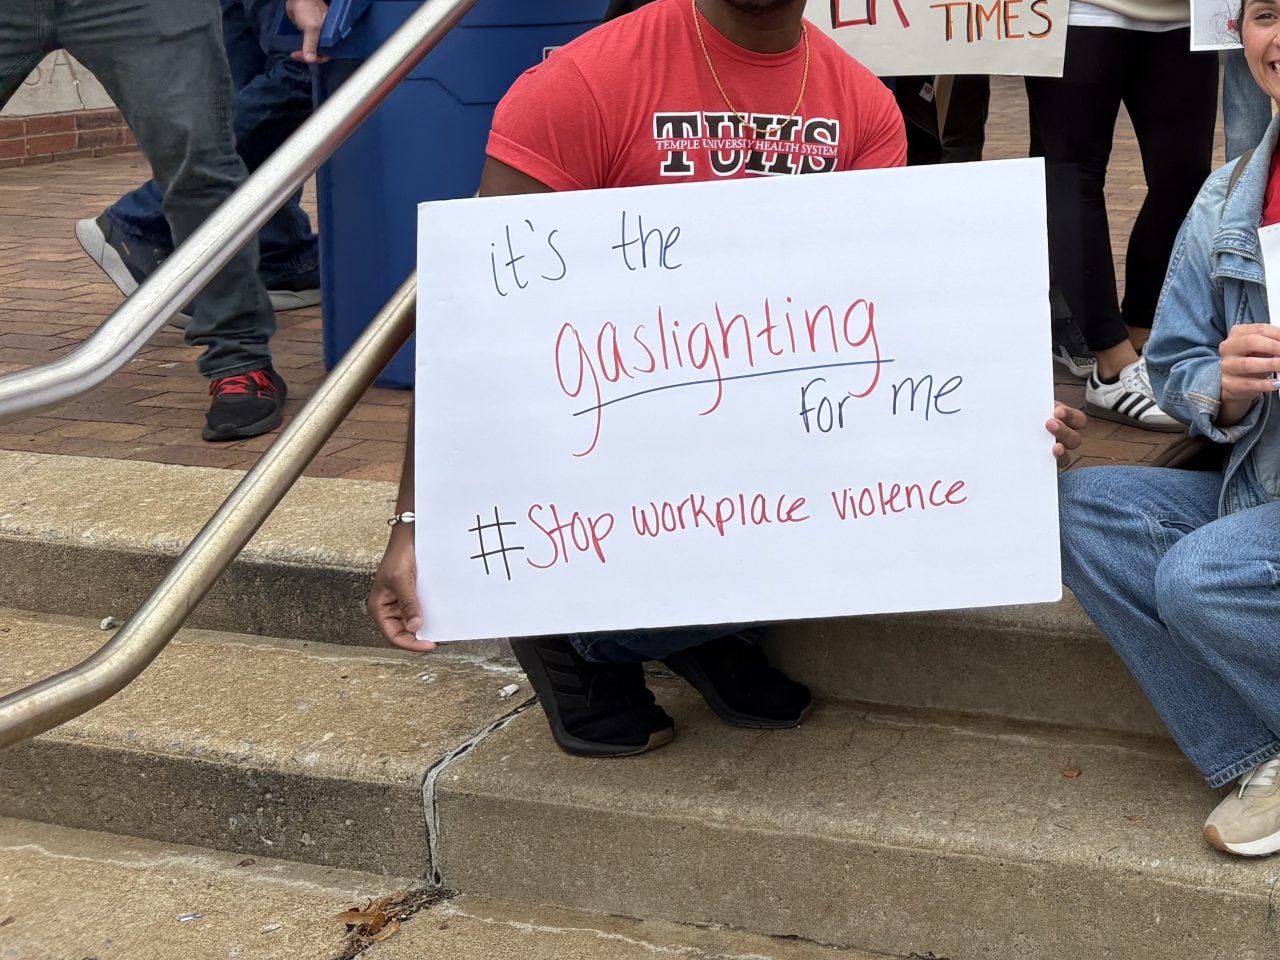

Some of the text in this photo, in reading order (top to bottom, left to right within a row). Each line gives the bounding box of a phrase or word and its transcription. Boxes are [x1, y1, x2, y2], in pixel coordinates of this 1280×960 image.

[653, 111, 840, 177] TUHS
[656, 138, 838, 157] TEMPLE UNIVERSIY HEALTH SYSTEM
[490, 210, 683, 297] it's the
[555, 296, 882, 458] gaslighting
[891, 373, 964, 422] me
[632, 492, 811, 538] workplace
